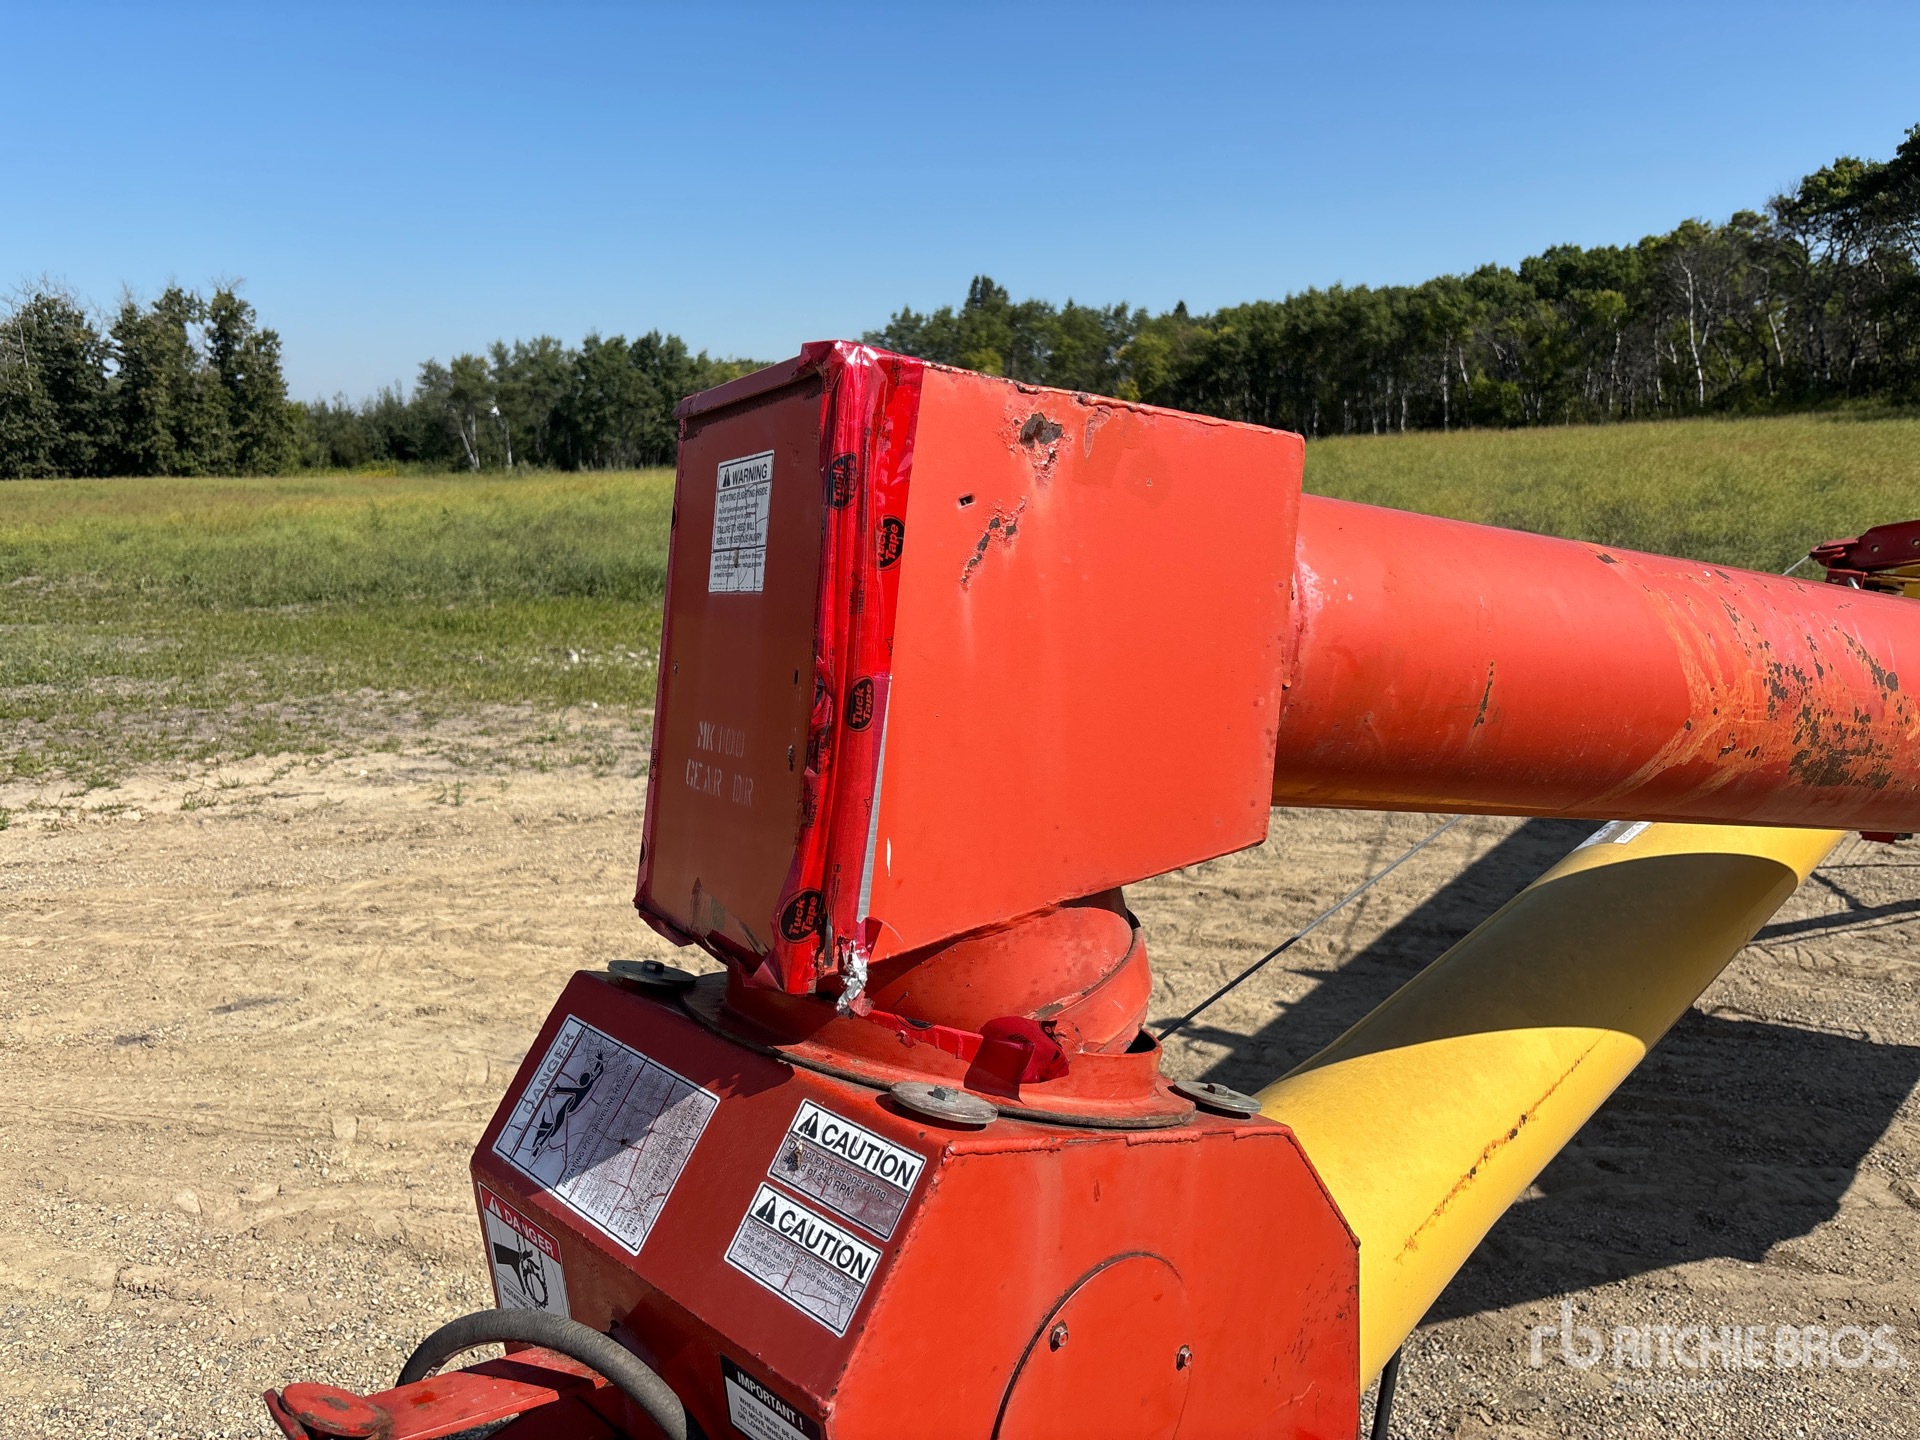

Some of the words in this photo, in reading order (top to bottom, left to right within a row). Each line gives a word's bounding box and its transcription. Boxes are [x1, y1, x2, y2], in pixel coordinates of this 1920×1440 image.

[731, 463, 767, 485] WARNING
[885, 524, 899, 559] Tape
[852, 687, 864, 724] Tuck
[863, 684, 872, 720] Tape
[788, 900, 805, 934] Tuck
[801, 896, 817, 932] Tape
[522, 1031, 575, 1115] DANGER
[561, 1150, 585, 1188] ROTATING
[582, 1133, 594, 1150] PTO
[591, 1095, 615, 1133] DRIVELINE
[612, 1063, 633, 1094] HAZARD
[801, 1148, 816, 1161] not
[814, 1154, 846, 1177] exceed
[844, 1170, 888, 1201] operating
[821, 1123, 916, 1187] CAUTION
[806, 1165, 817, 1178] of
[816, 1170, 833, 1186] 540
[832, 1179, 857, 1199] RPM.
[505, 1210, 554, 1257] DANGER
[778, 1209, 872, 1279] CAUTION
[737, 1241, 750, 1254] into
[749, 1249, 778, 1272] position.
[742, 1230, 755, 1243] line
[754, 1238, 771, 1253] after
[769, 1248, 794, 1269] having
[793, 1263, 816, 1282] raised
[815, 1277, 854, 1307] equipment
[747, 1220, 766, 1236] Close
[765, 1232, 783, 1247] valve
[783, 1242, 791, 1252] in
[790, 1247, 801, 1258] lift
[799, 1253, 827, 1276] cylinder
[826, 1269, 859, 1295] hydraulic
[737, 1371, 796, 1423] IMPORTANT
[737, 1411, 747, 1422] OR
[739, 1403, 748, 1415] TO
[748, 1411, 766, 1428] MOVE
[738, 1396, 763, 1418] WHEELS
[764, 1414, 780, 1431] MUST
[781, 1428, 790, 1439] BE
